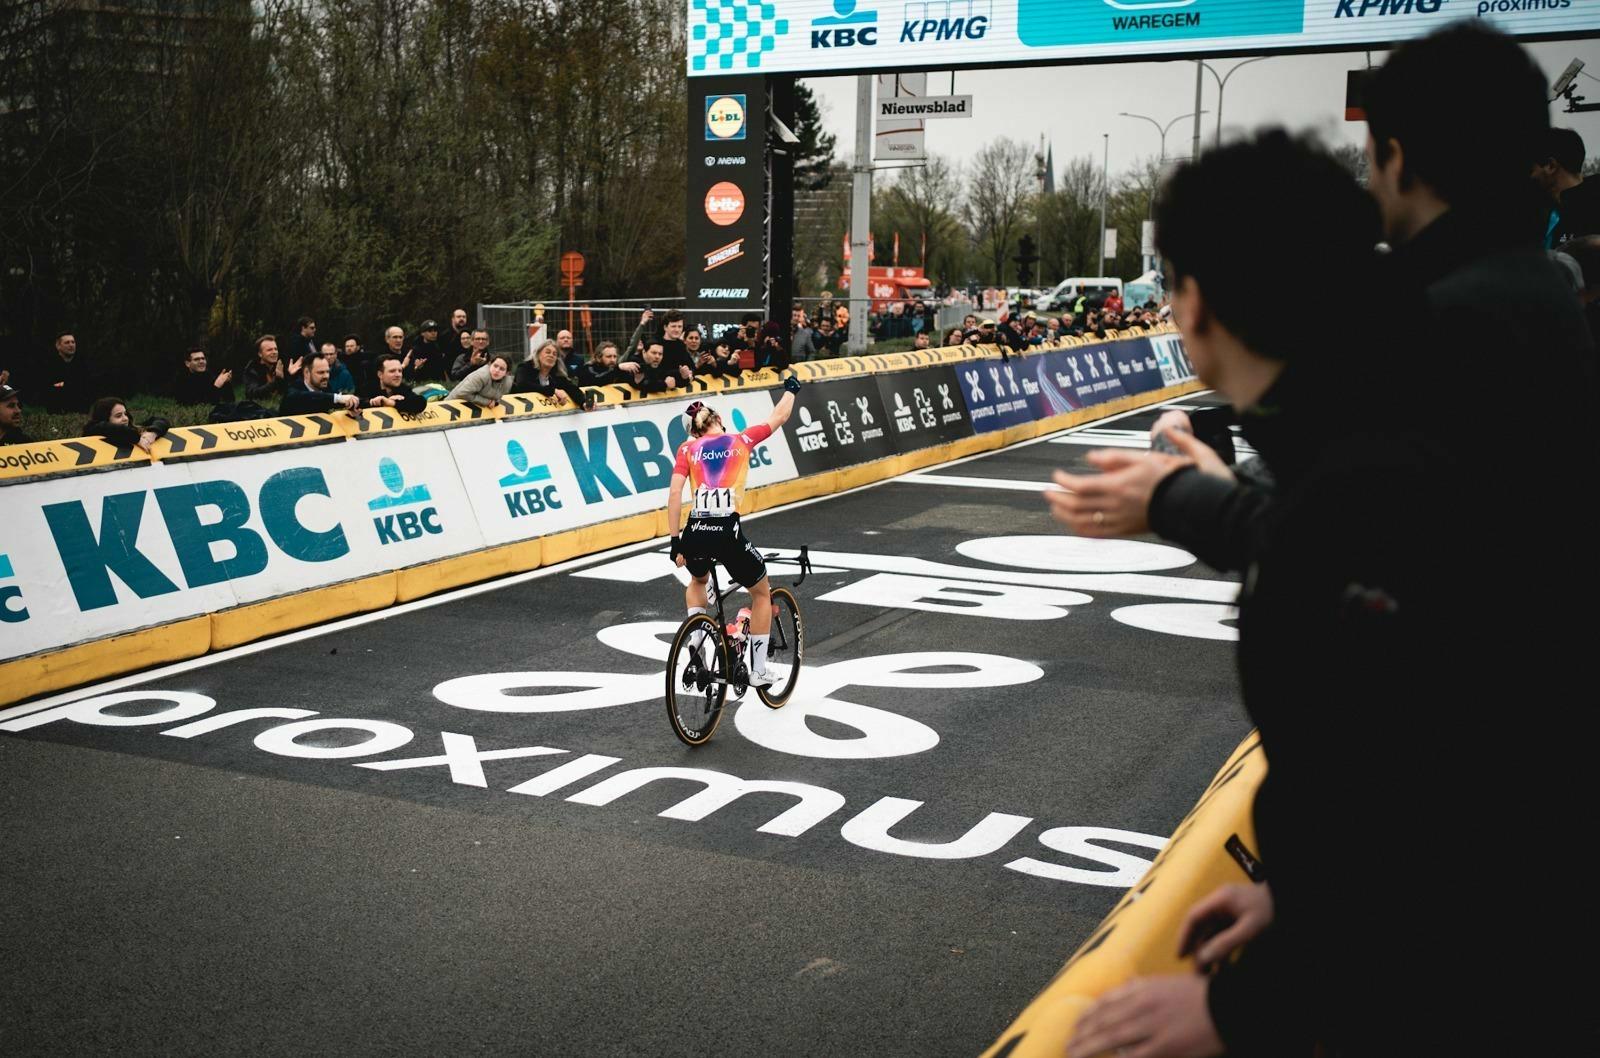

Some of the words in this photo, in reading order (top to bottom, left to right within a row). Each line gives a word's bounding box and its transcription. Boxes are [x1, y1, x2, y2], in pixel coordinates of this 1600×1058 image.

[900, 15, 988, 43] KPMG
[1112, 12, 1200, 31] WAREGEM
[811, 27, 877, 49] KBC
[881, 99, 966, 116] Nieuwsblad
[896, 415, 917, 433] KBC
[798, 432, 829, 453] KBC
[748, 445, 773, 469] BC
[503, 485, 563, 518] KBC
[373, 506, 444, 546] KBC
[42, 467, 351, 612] KBC
[0, 689, 1176, 888] proximus
